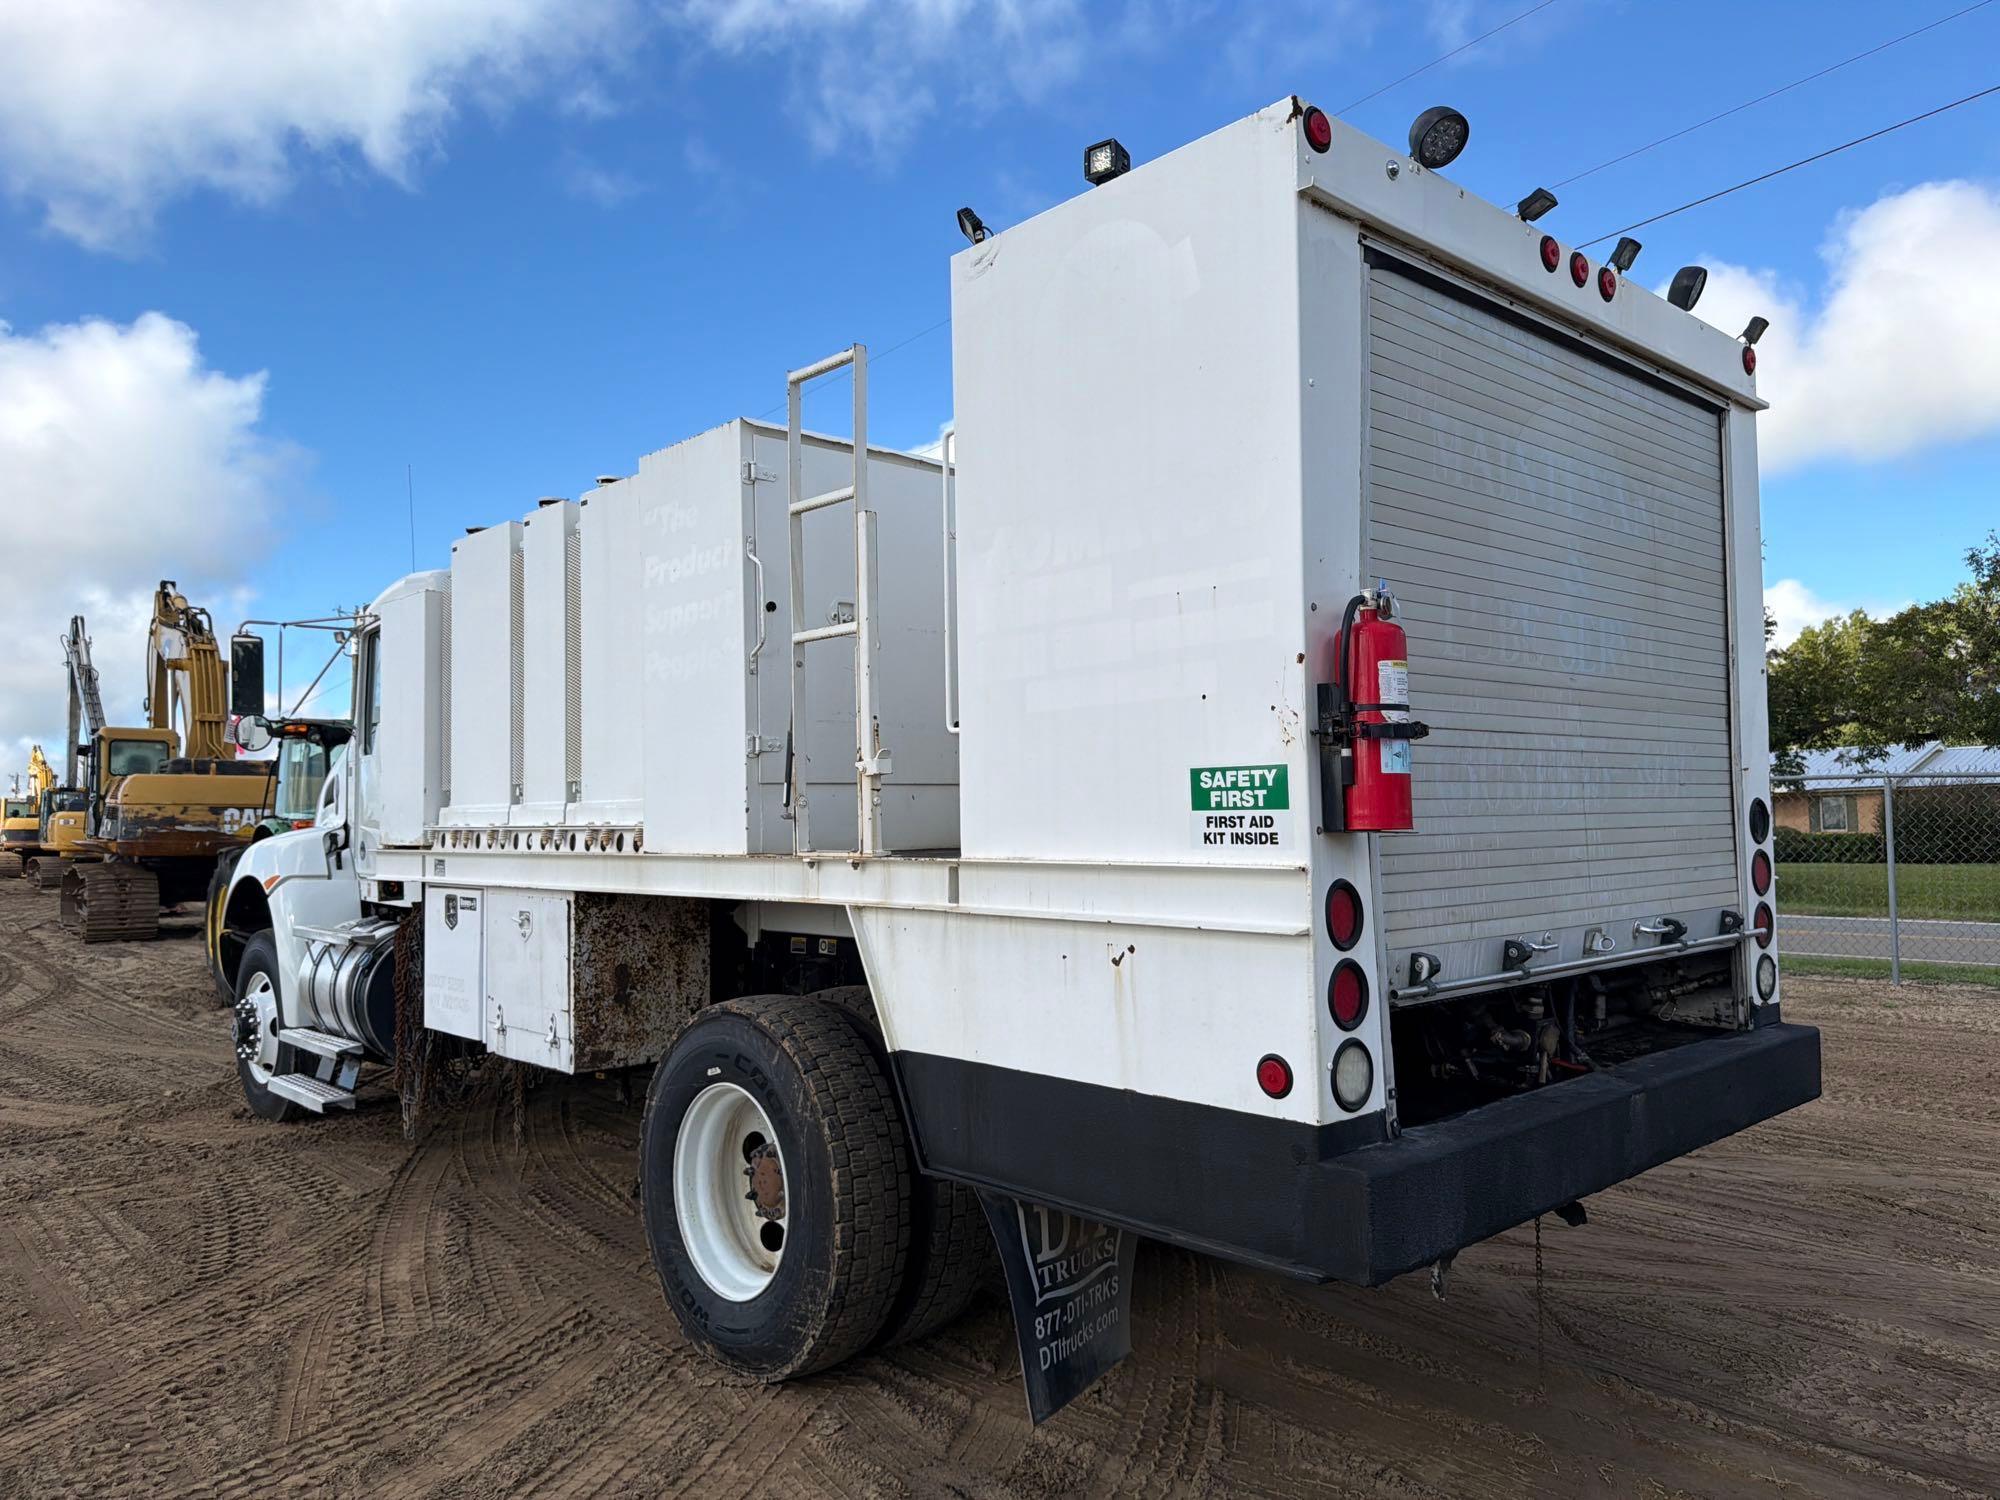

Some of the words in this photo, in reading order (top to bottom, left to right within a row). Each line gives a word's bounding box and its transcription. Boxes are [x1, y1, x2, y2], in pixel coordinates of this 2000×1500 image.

[1200, 769, 1277, 788] SAFETY
[1210, 789, 1267, 808] FIRST
[1206, 815, 1245, 829] FIRST
[1249, 815, 1274, 828] AID
[1203, 832, 1226, 845] KIT
[1230, 832, 1279, 845] INSIDE
[1038, 1237, 1114, 1288] TRUCKS
[1035, 1275, 1119, 1339] 877-DTI-TRKS
[1039, 1306, 1119, 1371] DTItruckscom
